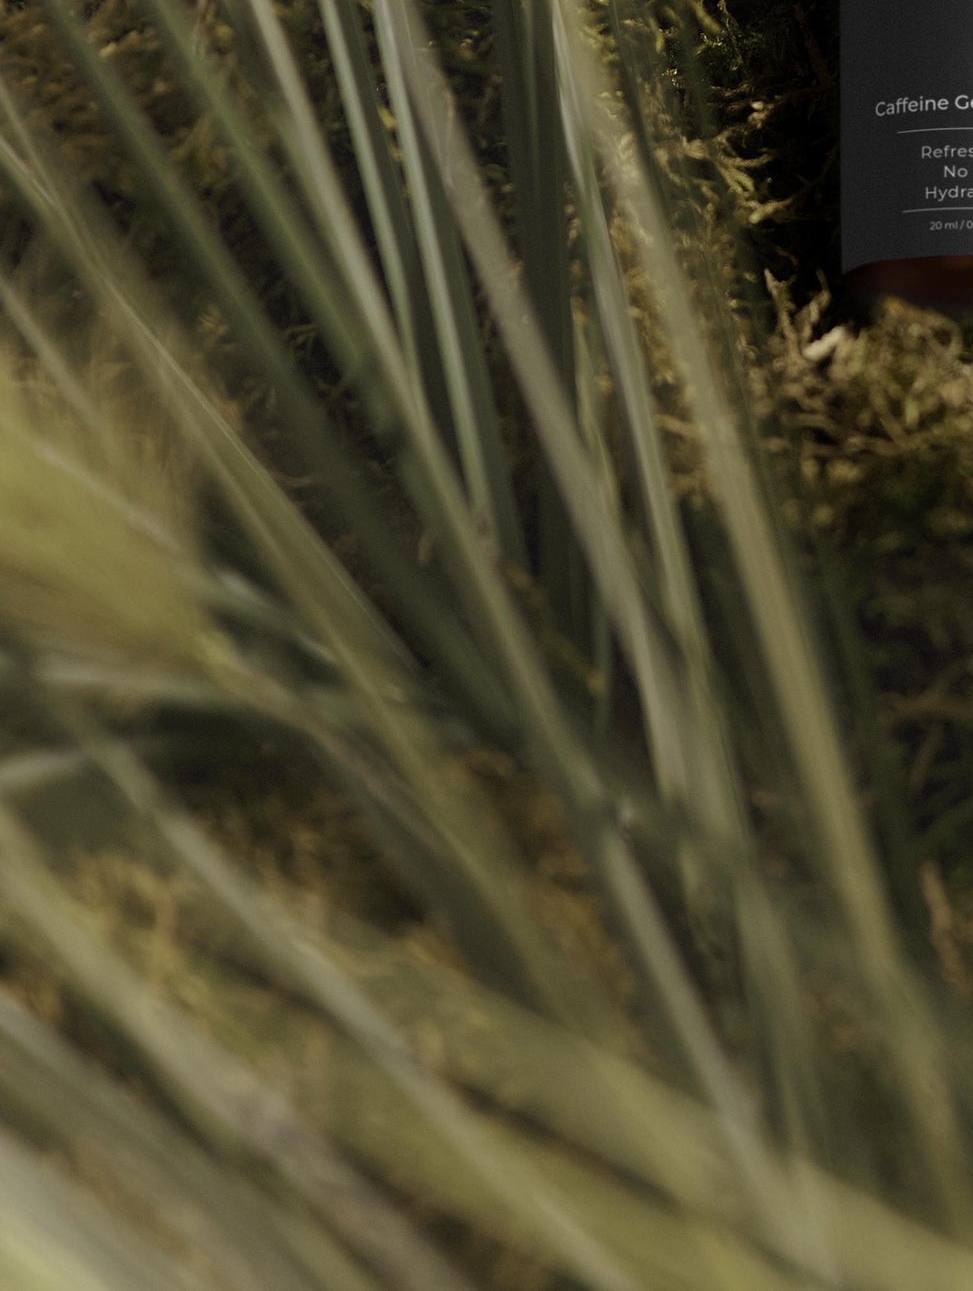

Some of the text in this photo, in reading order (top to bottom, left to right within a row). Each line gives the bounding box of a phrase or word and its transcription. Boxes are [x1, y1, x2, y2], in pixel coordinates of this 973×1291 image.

[875, 95, 949, 117] Caffeine
[943, 165, 968, 178] No
[929, 220, 943, 231] 20
[945, 220, 958, 230] ml
